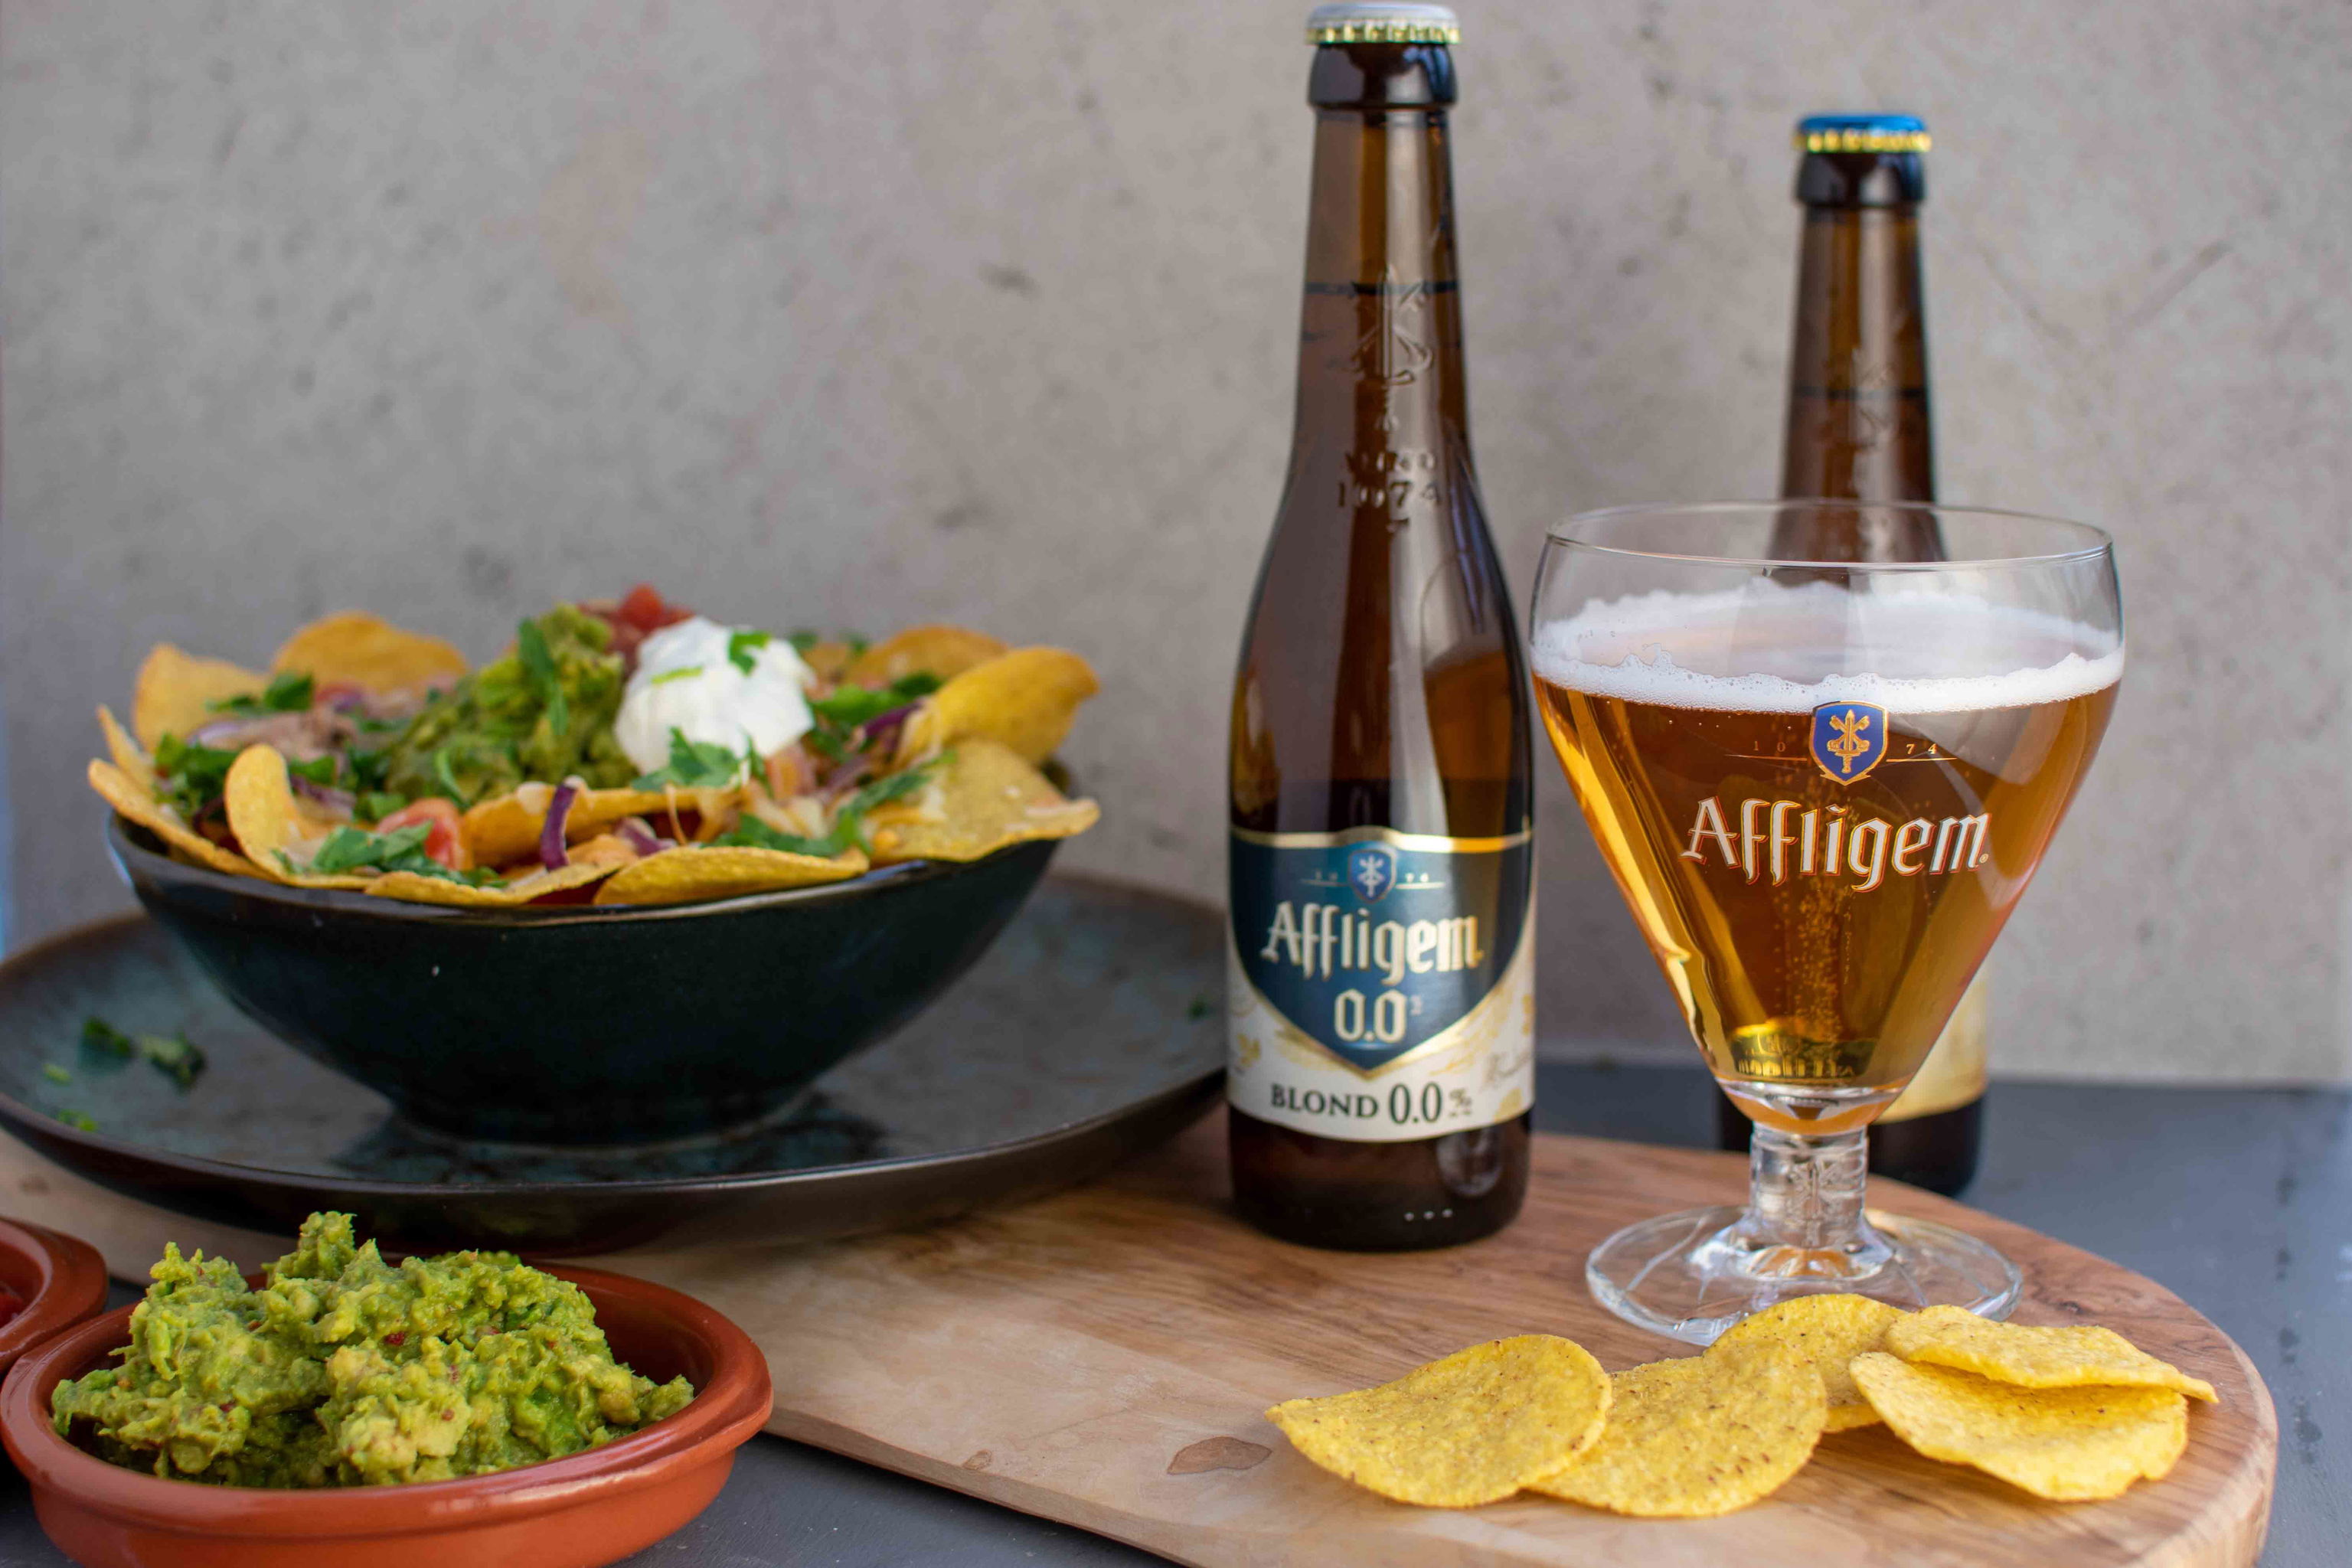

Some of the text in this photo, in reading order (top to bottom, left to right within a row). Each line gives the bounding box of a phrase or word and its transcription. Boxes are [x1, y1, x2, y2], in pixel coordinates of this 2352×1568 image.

[1753, 740, 1939, 756] 10 74
[1678, 795, 1991, 893] Affligem
[1260, 900, 1485, 986] Affligem
[1334, 988, 1406, 1043] 0.0
[1271, 1083, 1378, 1119] BLOND
